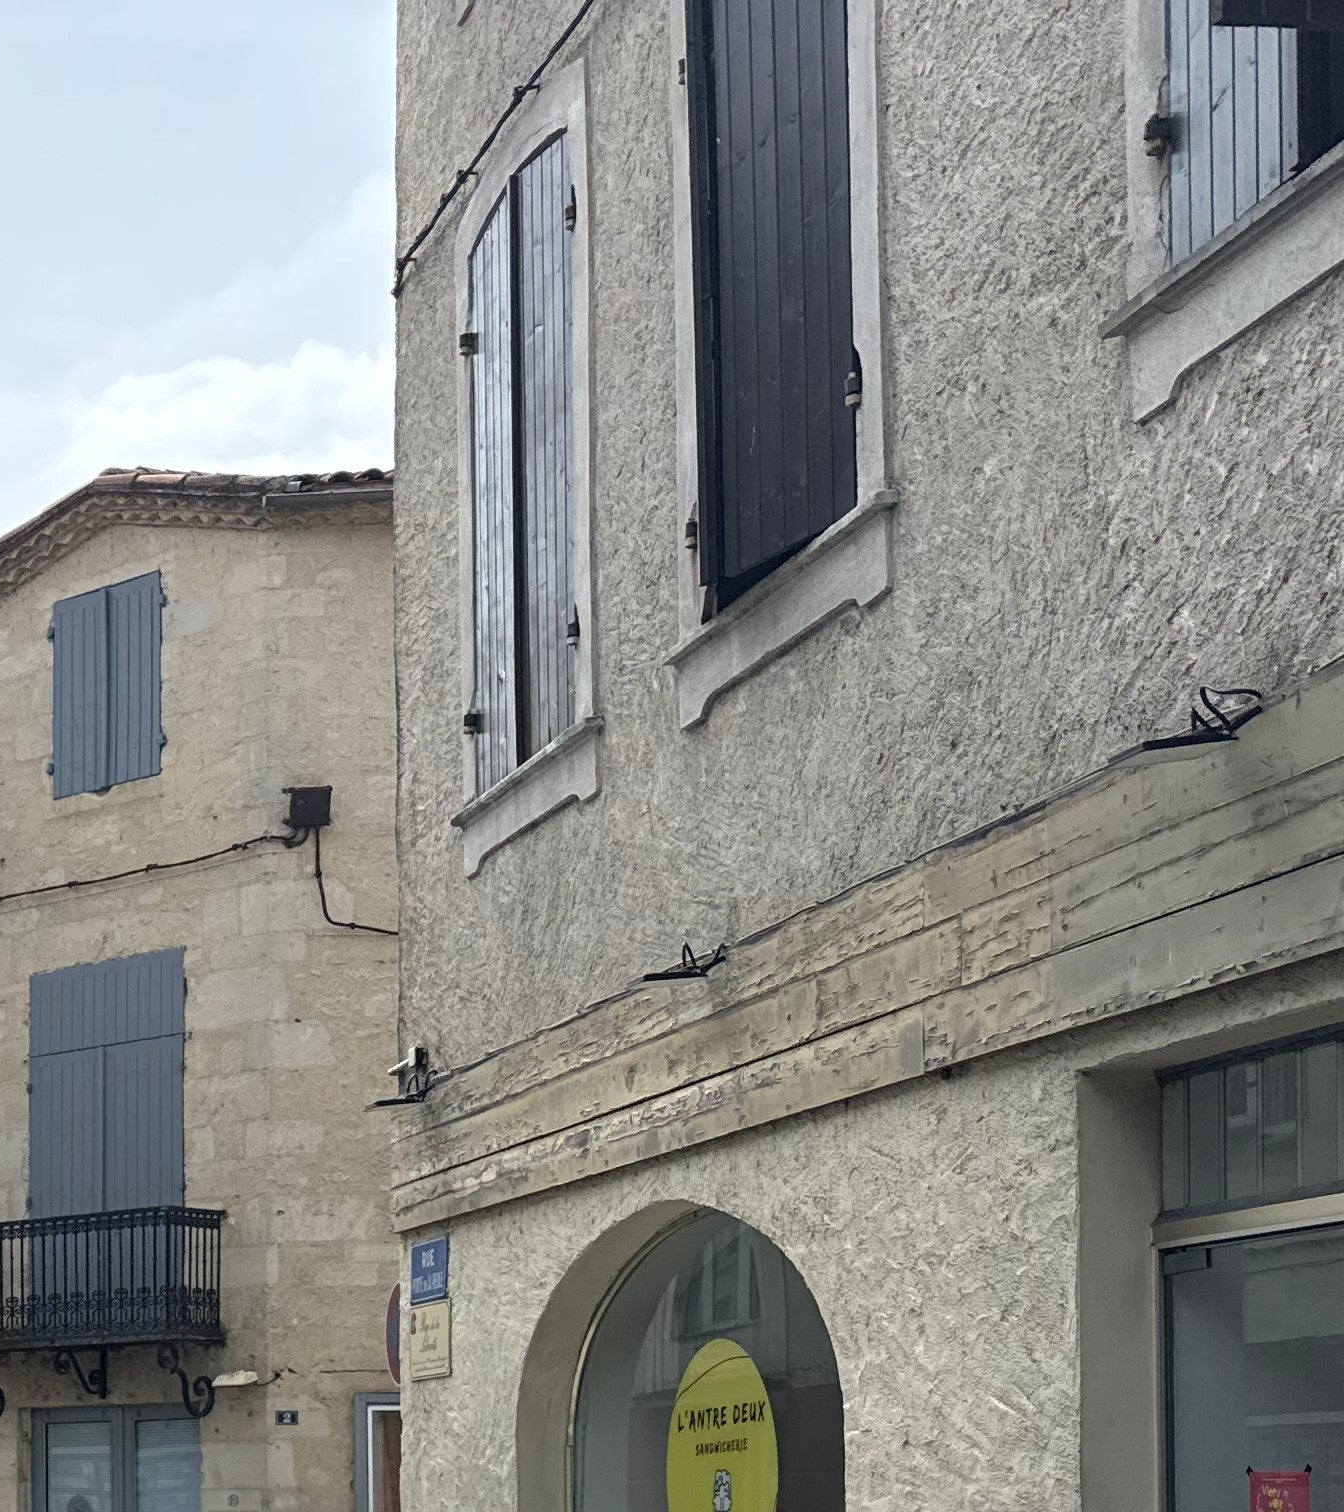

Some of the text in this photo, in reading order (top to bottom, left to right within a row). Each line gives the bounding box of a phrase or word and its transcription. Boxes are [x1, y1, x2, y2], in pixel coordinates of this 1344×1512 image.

[283, 1413, 292, 1423] 2
[678, 1400, 765, 1432] L'ANTRE DEUX
[696, 1438, 747, 1456] SANDWICHERIE
